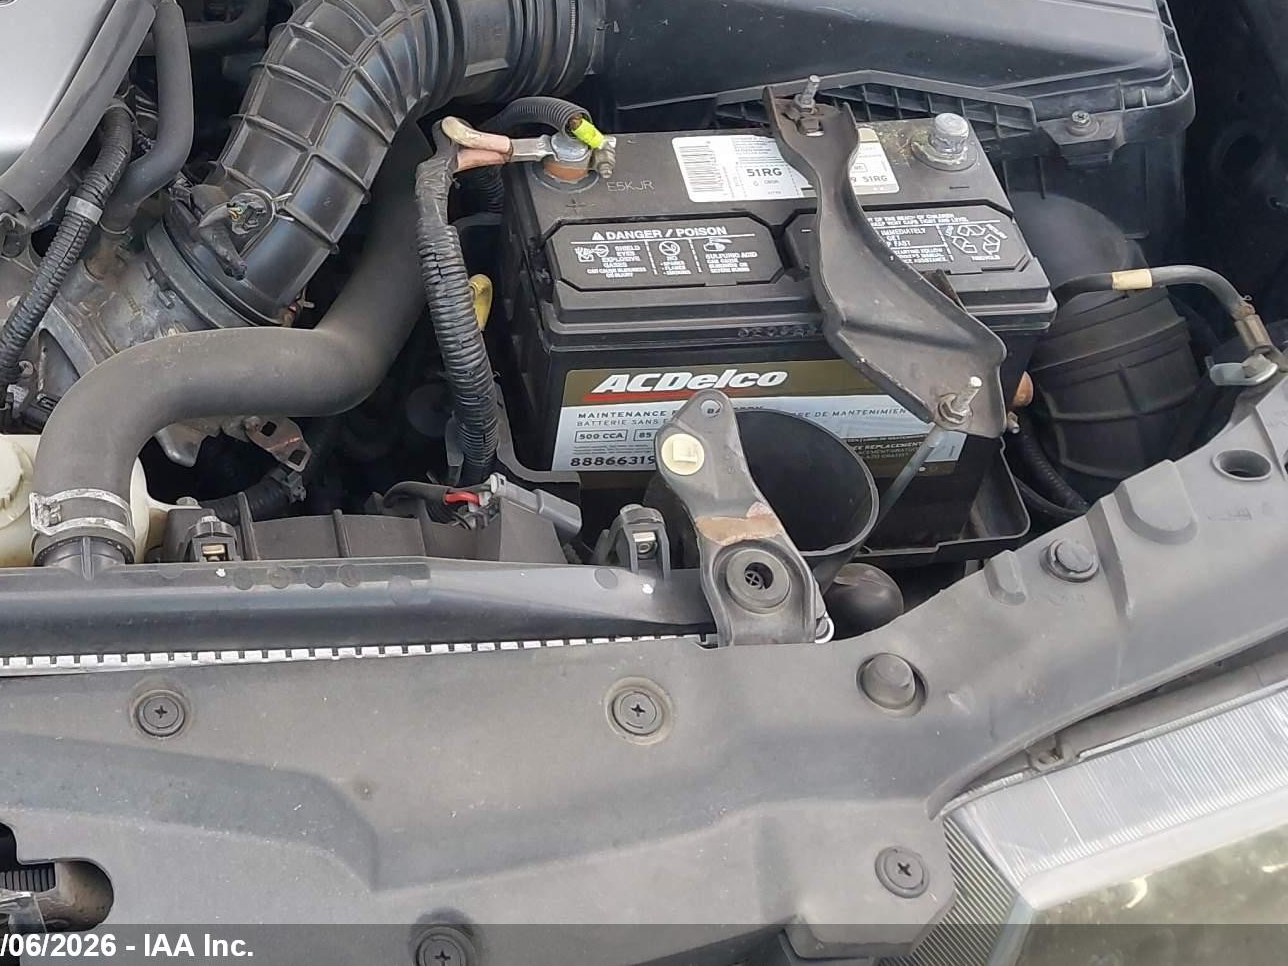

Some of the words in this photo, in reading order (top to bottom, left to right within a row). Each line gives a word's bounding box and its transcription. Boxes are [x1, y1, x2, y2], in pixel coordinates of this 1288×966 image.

[746, 168, 782, 176] 51RG
[862, 175, 888, 183] 51RG
[606, 229, 663, 240] DANGER
[676, 226, 728, 237] POISON
[880, 227, 926, 235] IMMEDIATELY
[592, 369, 788, 394] ACDelco
[578, 410, 667, 419] MAINTENANCE
[831, 408, 907, 417] MANTENIMIEN
[577, 419, 628, 427] BATTERIE
